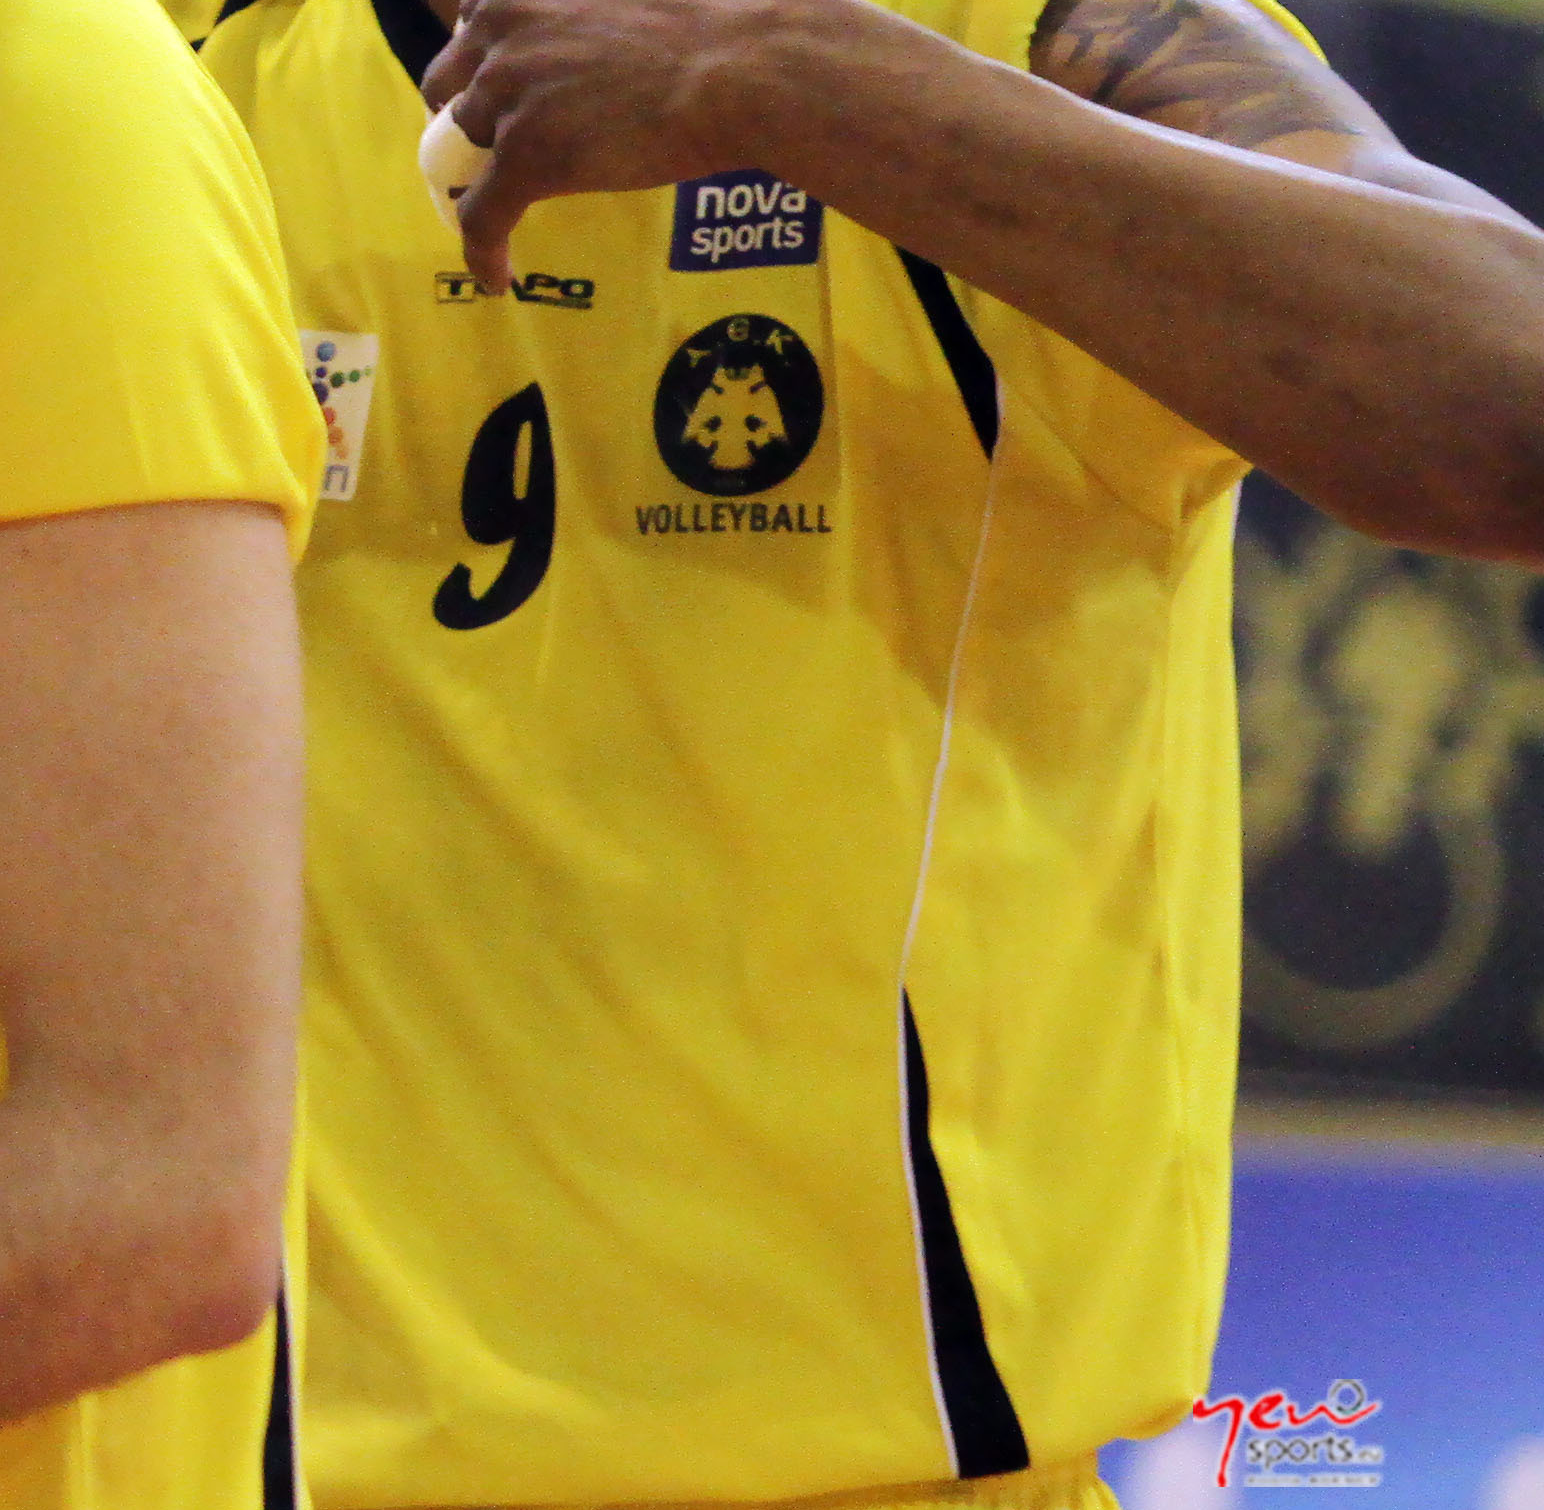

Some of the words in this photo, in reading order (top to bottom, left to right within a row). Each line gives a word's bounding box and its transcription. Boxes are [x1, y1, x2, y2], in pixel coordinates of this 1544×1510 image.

[690, 216, 805, 263] sports
[432, 381, 556, 630] 9
[635, 502, 832, 534] VOLLEYBALL
